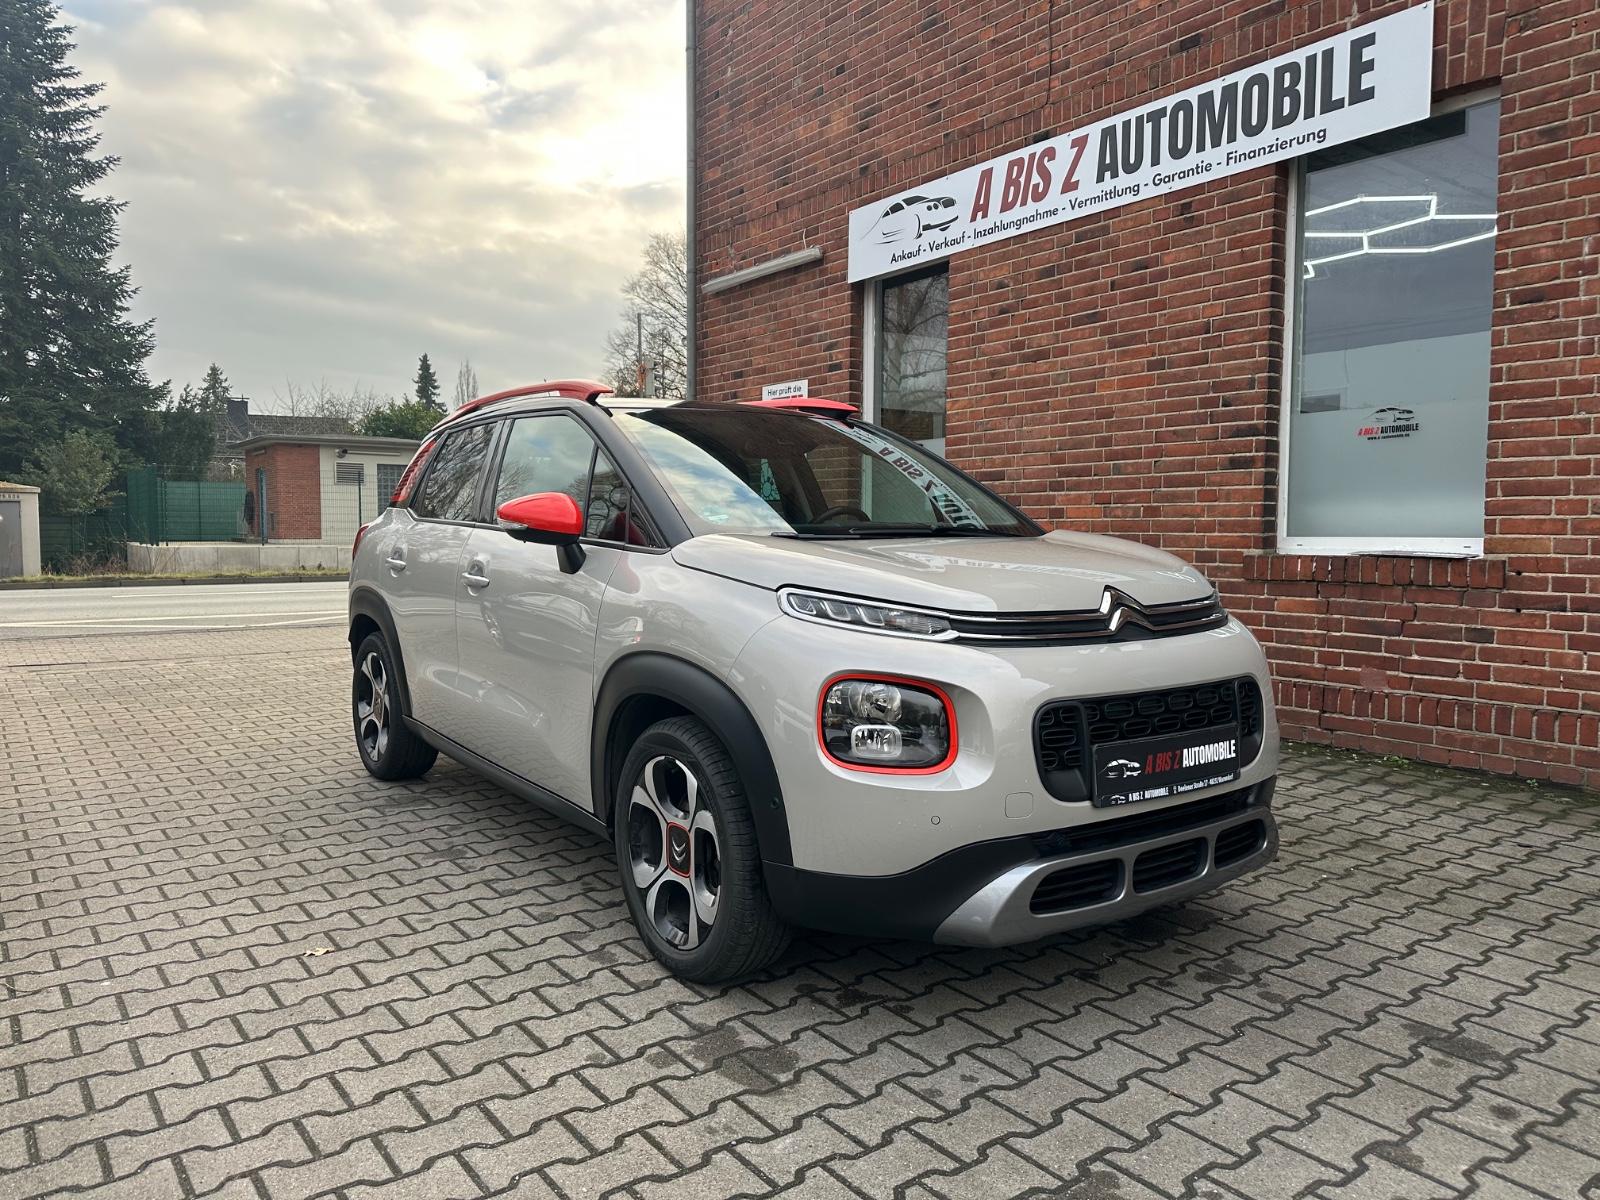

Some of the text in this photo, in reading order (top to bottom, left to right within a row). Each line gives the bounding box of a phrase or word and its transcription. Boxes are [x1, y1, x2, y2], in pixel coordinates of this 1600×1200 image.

[970, 32, 1376, 223] A BIS Z AUTOMOBILE
[890, 244, 923, 264] Ankauf
[928, 232, 966, 253] Verkauf
[973, 206, 1059, 240] Inzahlungnahme
[1068, 181, 1140, 211] Vermittlung
[1152, 159, 1213, 187] Garantie
[1226, 128, 1327, 166] Finanzierung
[767, 388, 778, 397] Hier
[778, 386, 792, 396] prüft
[793, 384, 802, 393] die
[1380, 422, 1419, 434] AUTOMOBILE
[1145, 739, 1236, 774] A BIS Z AUTOMOBILE
